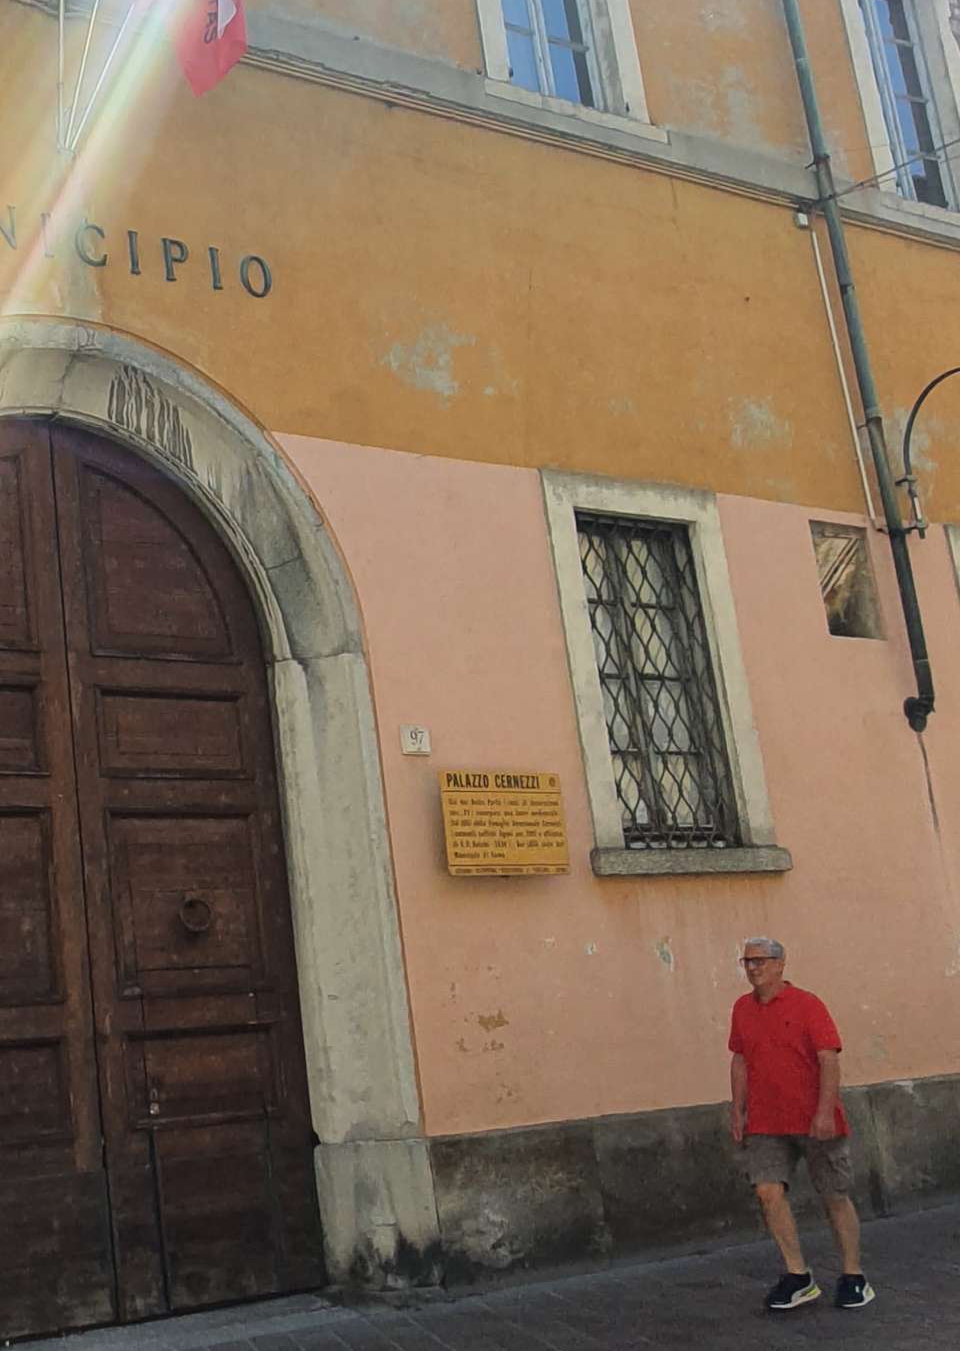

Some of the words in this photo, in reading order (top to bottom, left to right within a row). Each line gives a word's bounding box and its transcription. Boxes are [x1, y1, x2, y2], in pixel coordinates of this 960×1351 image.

[410, 729, 425, 746] 97
[446, 773, 489, 788] PALAZZO
[495, 774, 540, 789] CERNEZZI
